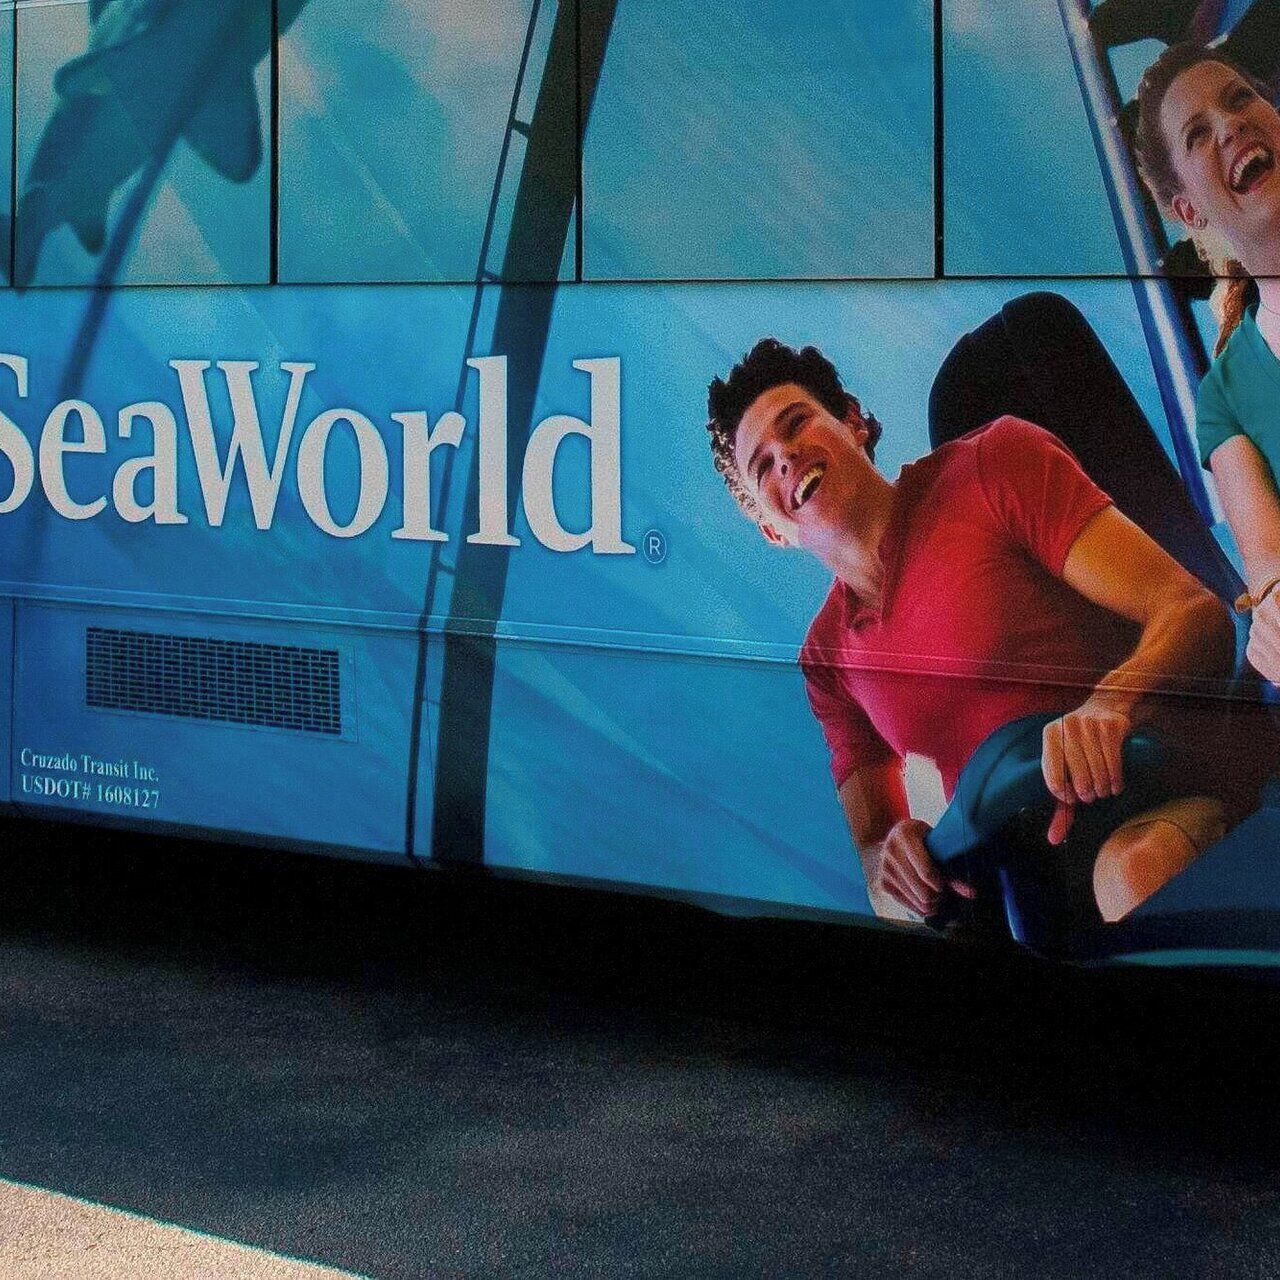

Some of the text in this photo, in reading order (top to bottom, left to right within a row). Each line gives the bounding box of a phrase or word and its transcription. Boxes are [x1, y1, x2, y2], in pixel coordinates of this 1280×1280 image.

[21, 747, 160, 783] Cruzado Transit Inc.
[21, 774, 160, 809] USDOT# 1608127
